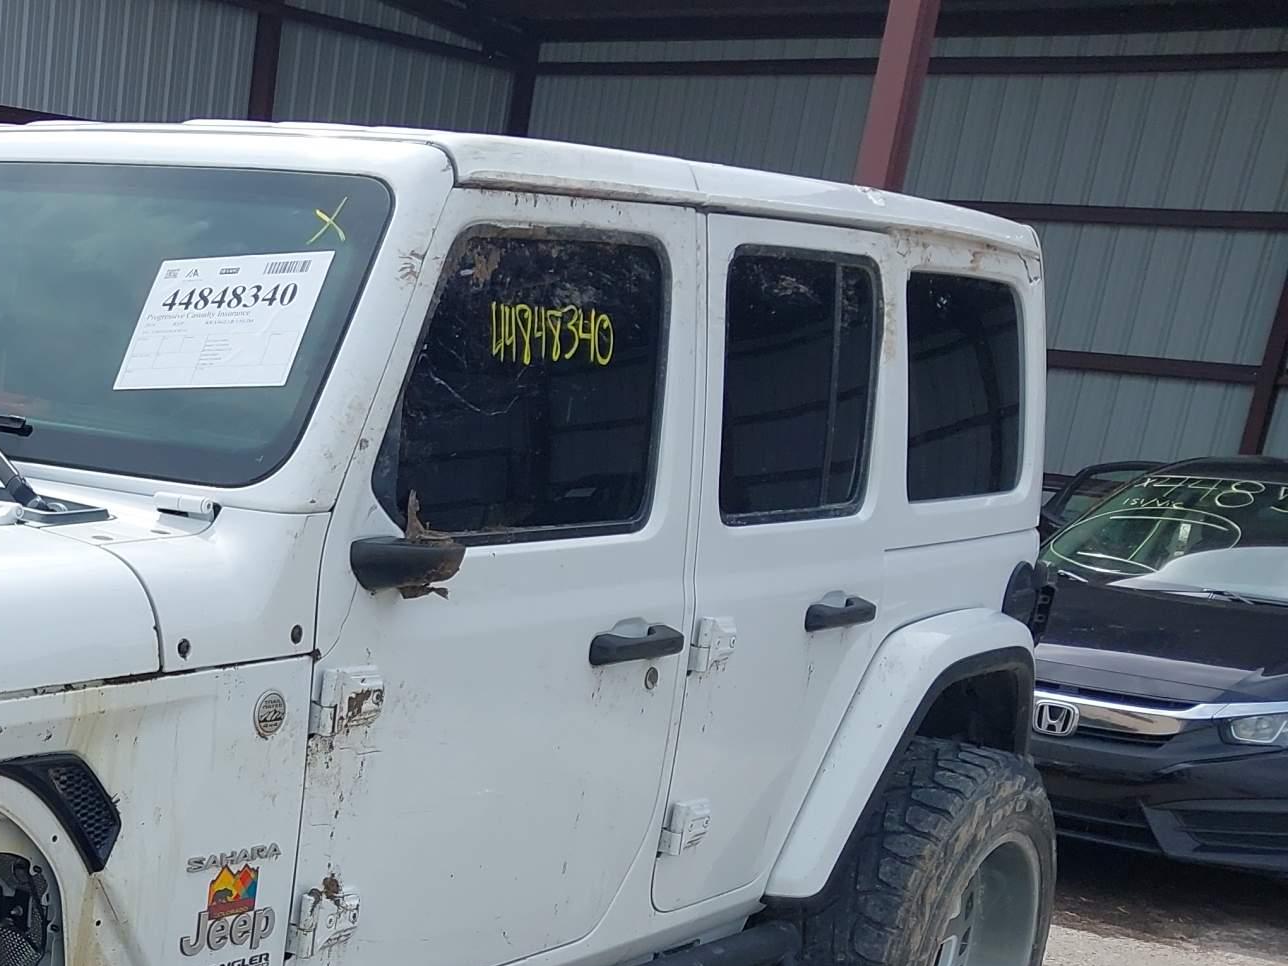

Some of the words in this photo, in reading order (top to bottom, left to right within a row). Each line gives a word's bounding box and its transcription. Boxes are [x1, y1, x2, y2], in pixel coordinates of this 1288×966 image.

[162, 283, 298, 311] 44848340
[491, 301, 613, 365] 44848340
[187, 843, 281, 873] SAHARA
[180, 906, 275, 957] Jeep
